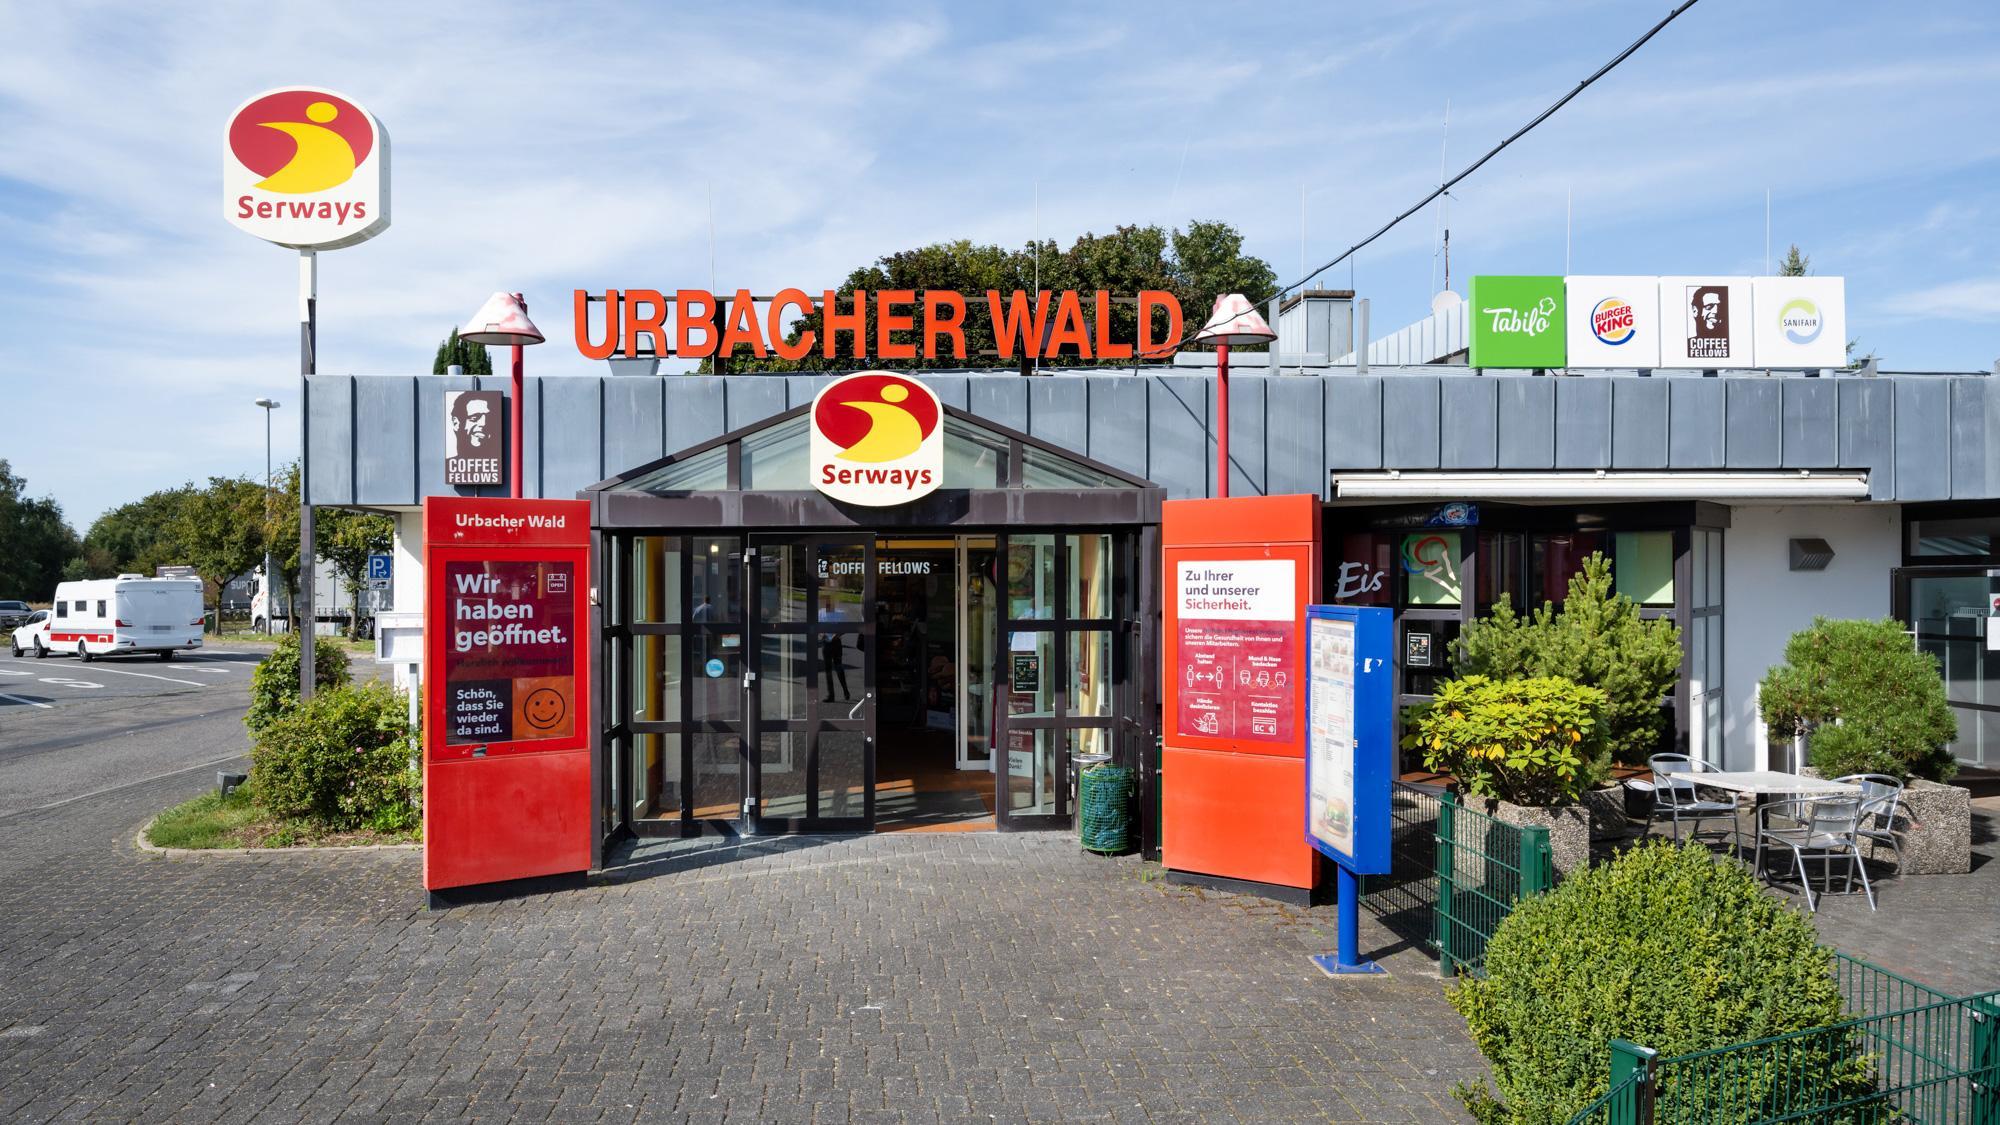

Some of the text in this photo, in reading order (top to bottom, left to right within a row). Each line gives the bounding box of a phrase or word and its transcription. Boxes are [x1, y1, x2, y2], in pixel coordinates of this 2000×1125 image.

[238, 195, 366, 225] Serways
[1595, 306, 1632, 323] BURGER
[573, 288, 1184, 360] URBACHER WALD
[1483, 307, 1550, 337] Tabilo
[1597, 315, 1634, 335] KING
[1783, 319, 1817, 327] SANIFAIR
[1690, 338, 1728, 349] COFFEE
[1690, 349, 1728, 357] FELLOWS
[449, 458, 499, 473] COFFEE
[449, 473, 499, 483] FELLOWS
[822, 464, 932, 490] Serways
[455, 513, 566, 528] Urbacher Wald
[372, 558, 385, 576] P
[832, 561, 930, 575] COFF FELLOWS
[1185, 569, 1234, 581] Zu Ihrer
[1337, 561, 1385, 598] Eis
[455, 573, 501, 594] Wir
[1185, 584, 1261, 596] und unserer
[456, 598, 534, 620] haben
[1185, 598, 1252, 610] Sicherheit.
[455, 623, 568, 653] geöffnet.
[1213, 634, 1244, 642] Gesundheit
[456, 688, 497, 700] Schön,
[456, 699, 504, 711] dass Sie
[456, 711, 499, 723] wieder
[456, 722, 503, 735] da sind.
[1254, 723, 1265, 732] EC
